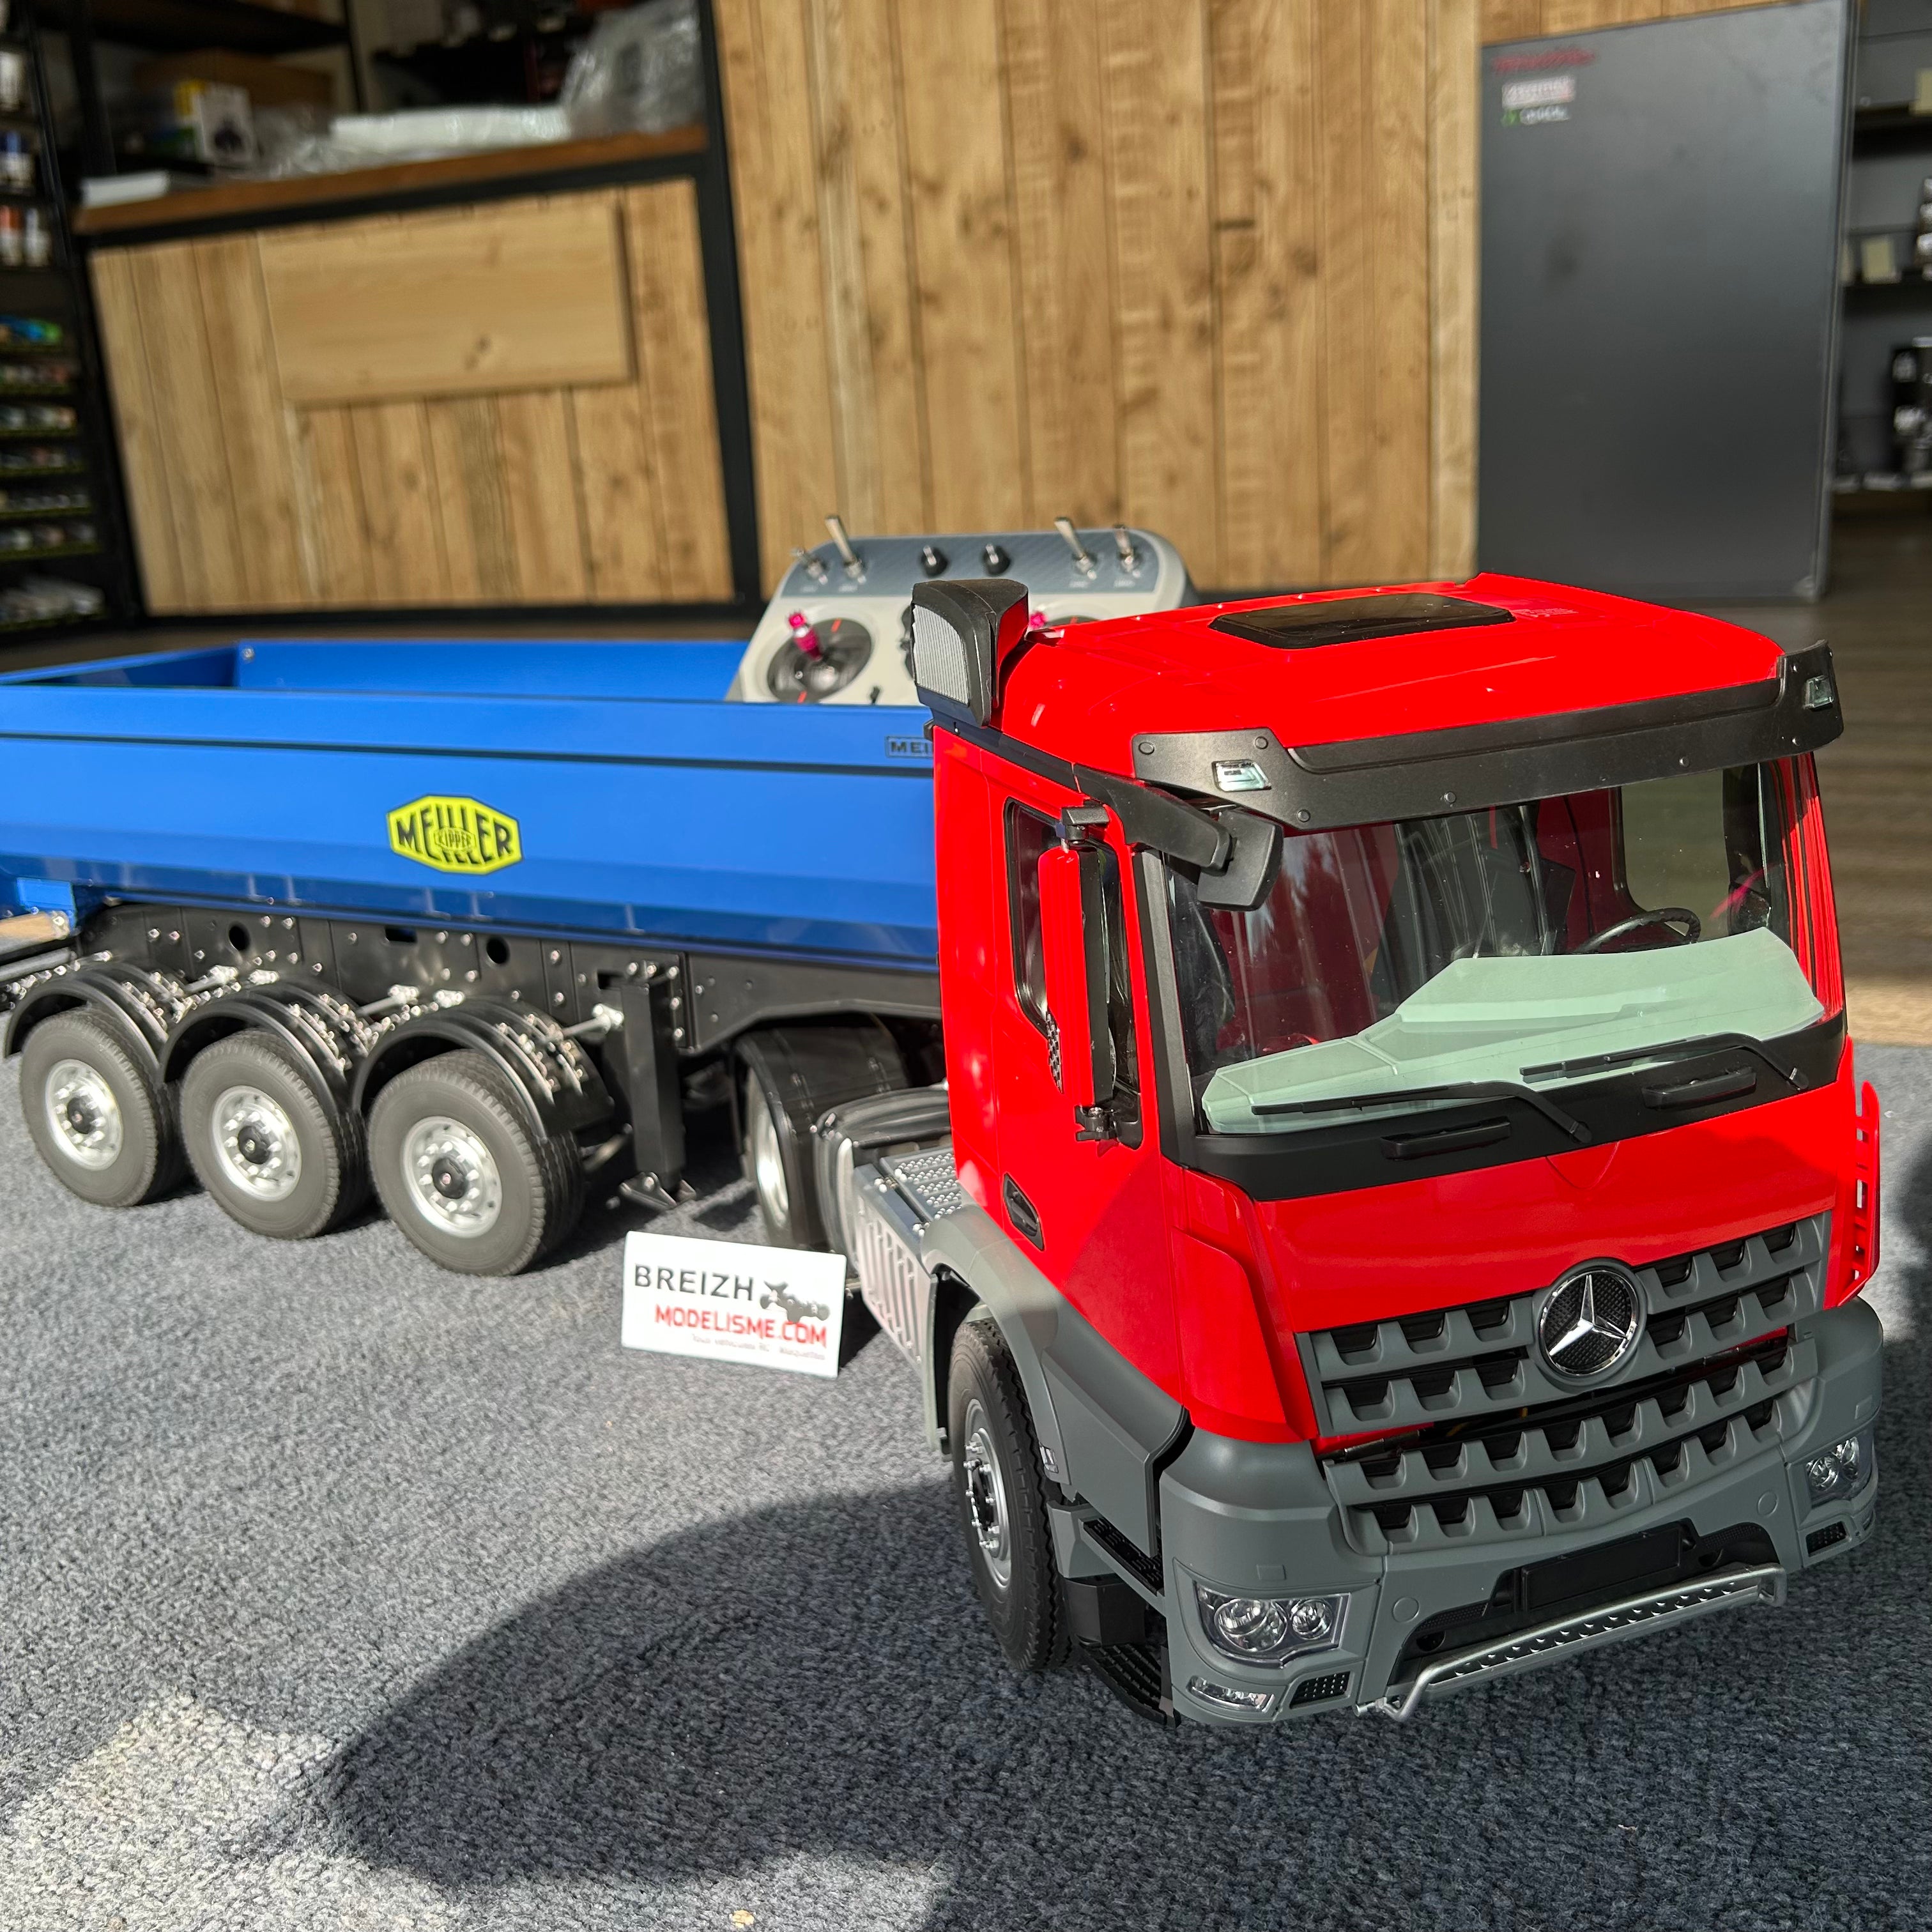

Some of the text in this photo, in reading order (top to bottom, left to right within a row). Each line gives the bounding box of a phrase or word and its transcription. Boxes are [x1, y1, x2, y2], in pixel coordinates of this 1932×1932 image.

[891, 741, 928, 753] MEI
[396, 803, 512, 864] MEILLER
[634, 1263, 753, 1301] BREIZH
[654, 1303, 827, 1347] MODELISME.COM
